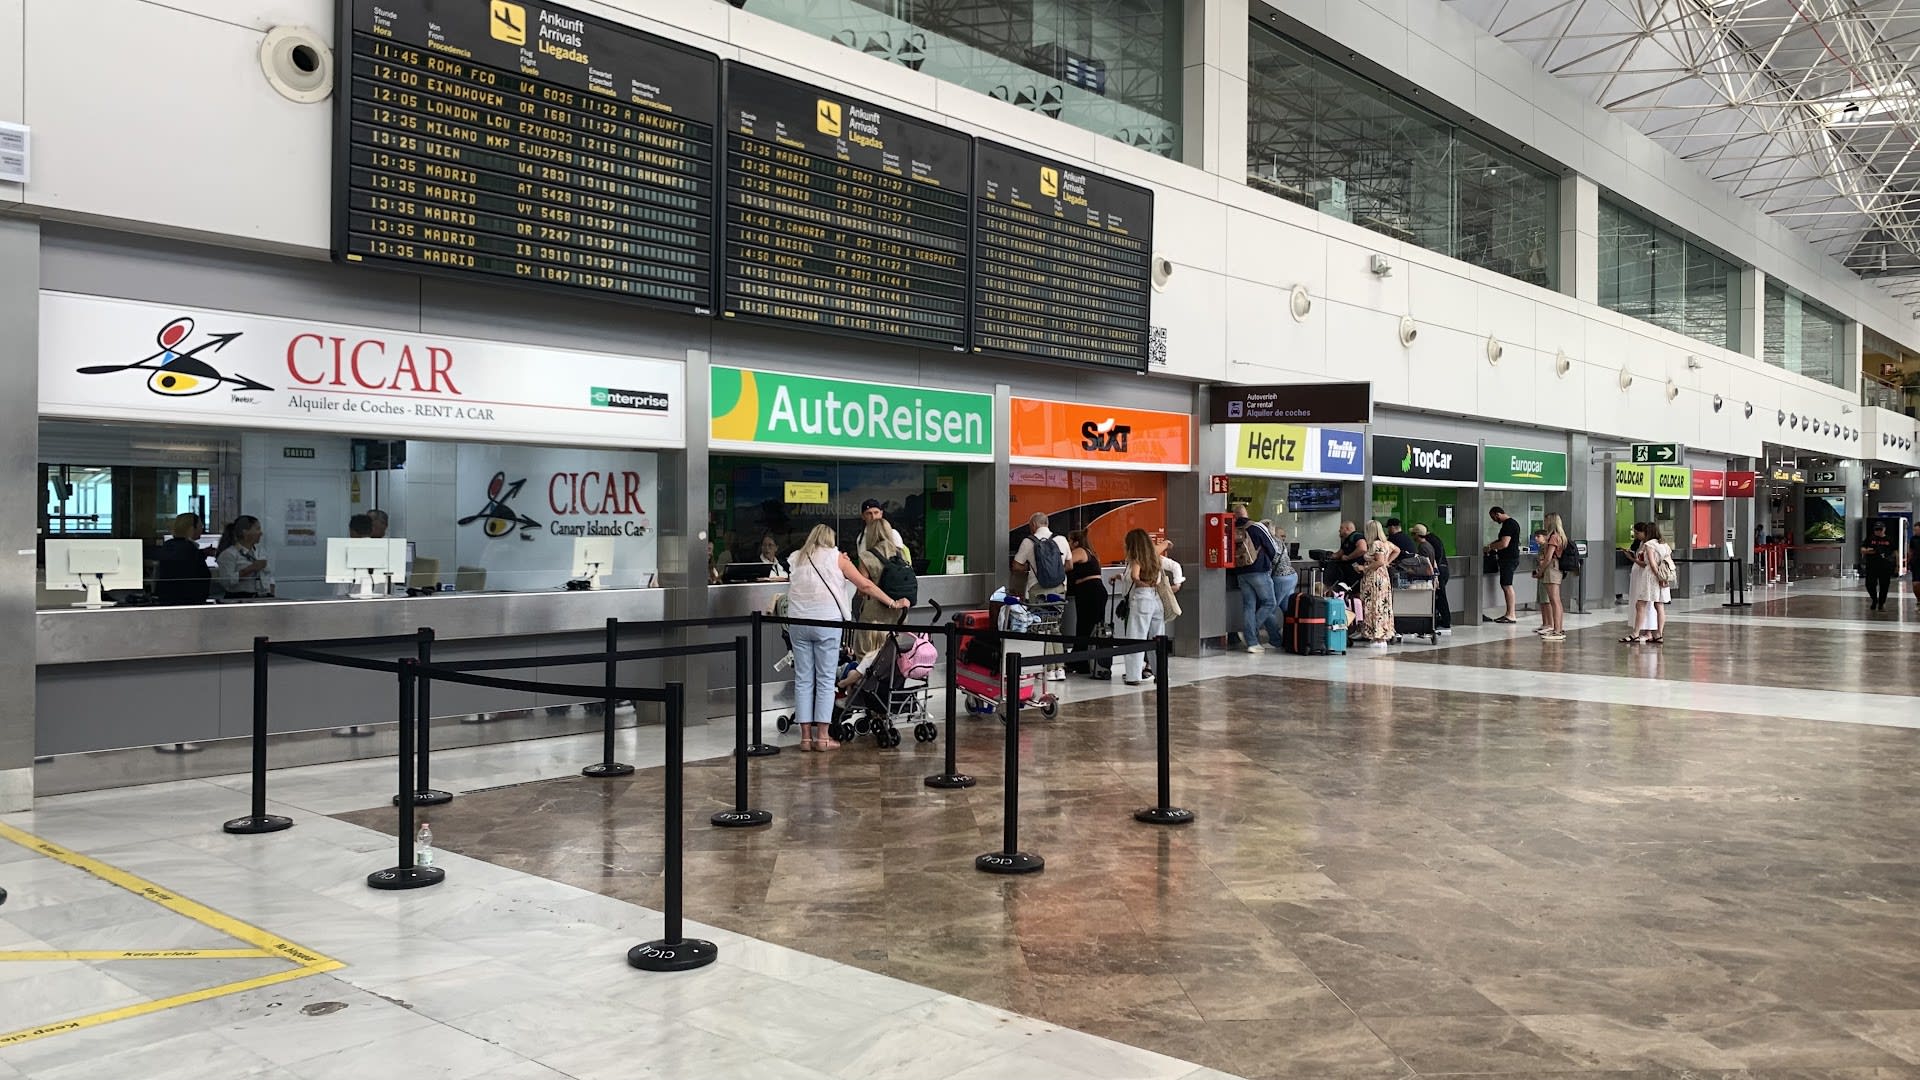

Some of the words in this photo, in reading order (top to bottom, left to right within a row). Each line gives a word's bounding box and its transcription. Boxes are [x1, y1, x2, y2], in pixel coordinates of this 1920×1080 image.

[374, 7, 397, 19] Stunde
[374, 16, 391, 26] Time
[539, 9, 585, 34] Ankunft
[374, 25, 392, 37] Hora
[428, 22, 441, 31] Von
[428, 31, 445, 41] From
[538, 25, 582, 48] Arrivals
[428, 40, 471, 58] Procedencia
[538, 39, 589, 65] Llegadas
[374, 43, 418, 66] 11:45
[428, 57, 462, 77] ROMA
[470, 68, 495, 85] FCO
[543, 87, 573, 105] 6035
[581, 97, 616, 116] 11:32
[624, 108, 631, 120] A
[638, 112, 684, 134] ANKUNFT
[373, 64, 417, 87] 12:00
[427, 78, 502, 108] EINDHOVEN
[519, 101, 535, 115] OR
[543, 107, 573, 125] 1681
[581, 116, 616, 135] 11:37
[624, 127, 630, 139] A
[638, 131, 684, 152] ANKUNFT
[849, 105, 881, 124] Ankunft
[373, 86, 417, 108] 12:05
[427, 99, 478, 122] LONDON
[518, 121, 572, 144] EZY8033
[580, 136, 616, 154] 12:15
[623, 146, 630, 158] A
[637, 149, 684, 170] ANKUNFT
[849, 120, 879, 135] Arrivals
[372, 108, 416, 130] 12:35
[426, 120, 477, 143] MILANO
[485, 134, 510, 150] MXP
[518, 141, 572, 164] EJU3769
[580, 155, 615, 173] 12:21
[623, 165, 629, 176] A
[637, 168, 683, 188] ANKUNFT
[849, 130, 884, 150] Llegadas
[371, 130, 416, 151] 13:25
[542, 166, 571, 183] 2831
[580, 175, 615, 192] 13:18
[623, 184, 629, 195] A
[371, 152, 415, 172] 13:35
[425, 163, 476, 184] MADRID
[517, 181, 533, 195] AT
[541, 186, 571, 203] 5429
[579, 194, 615, 211] 13:37
[622, 203, 629, 214] A
[1063, 180, 1085, 195] Arrivals
[370, 174, 415, 194] 13:35
[425, 184, 476, 205] MADRID
[517, 202, 533, 215] VY
[541, 206, 571, 222] 5458
[579, 213, 614, 231] 13:37
[622, 222, 628, 233] A
[370, 196, 414, 215] 13:35
[424, 205, 475, 226] MADRID
[540, 226, 570, 242] 7247
[578, 233, 614, 250] 13:37
[622, 241, 628, 252] A
[369, 218, 414, 237] 13:35
[424, 227, 475, 246] MADRID
[516, 242, 532, 256] IB
[540, 246, 570, 262] 3910
[578, 253, 613, 269] 13:37
[621, 260, 628, 271] A
[368, 240, 413, 258] 13:35
[423, 248, 474, 267] MADRID
[515, 262, 531, 276] CX
[540, 266, 569, 281] 1847
[578, 272, 613, 288] 13:37
[621, 279, 627, 290] A
[287, 333, 462, 395] CICAR
[288, 396, 338, 413] Alquiler
[343, 398, 357, 411] de
[360, 400, 405, 415] Coches
[415, 404, 453, 417] RENT
[455, 408, 464, 418] A
[467, 408, 495, 420] CAR
[592, 392, 668, 408] enterprise
[768, 385, 982, 445] AutoReisen
[1246, 409, 1274, 417] Alquiler
[1274, 409, 1284, 417] de
[1285, 409, 1311, 417] coches
[1247, 431, 1296, 462] Hertz
[1328, 439, 1357, 464] Thrifty
[1413, 447, 1453, 473] TopCar
[1511, 456, 1544, 473] Europcar
[1616, 469, 1644, 486] GOLDCAR
[1659, 474, 1685, 488] GOLDCAR
[548, 471, 646, 515] CICAR
[550, 520, 585, 538] Canary
[587, 520, 622, 537] Islands
